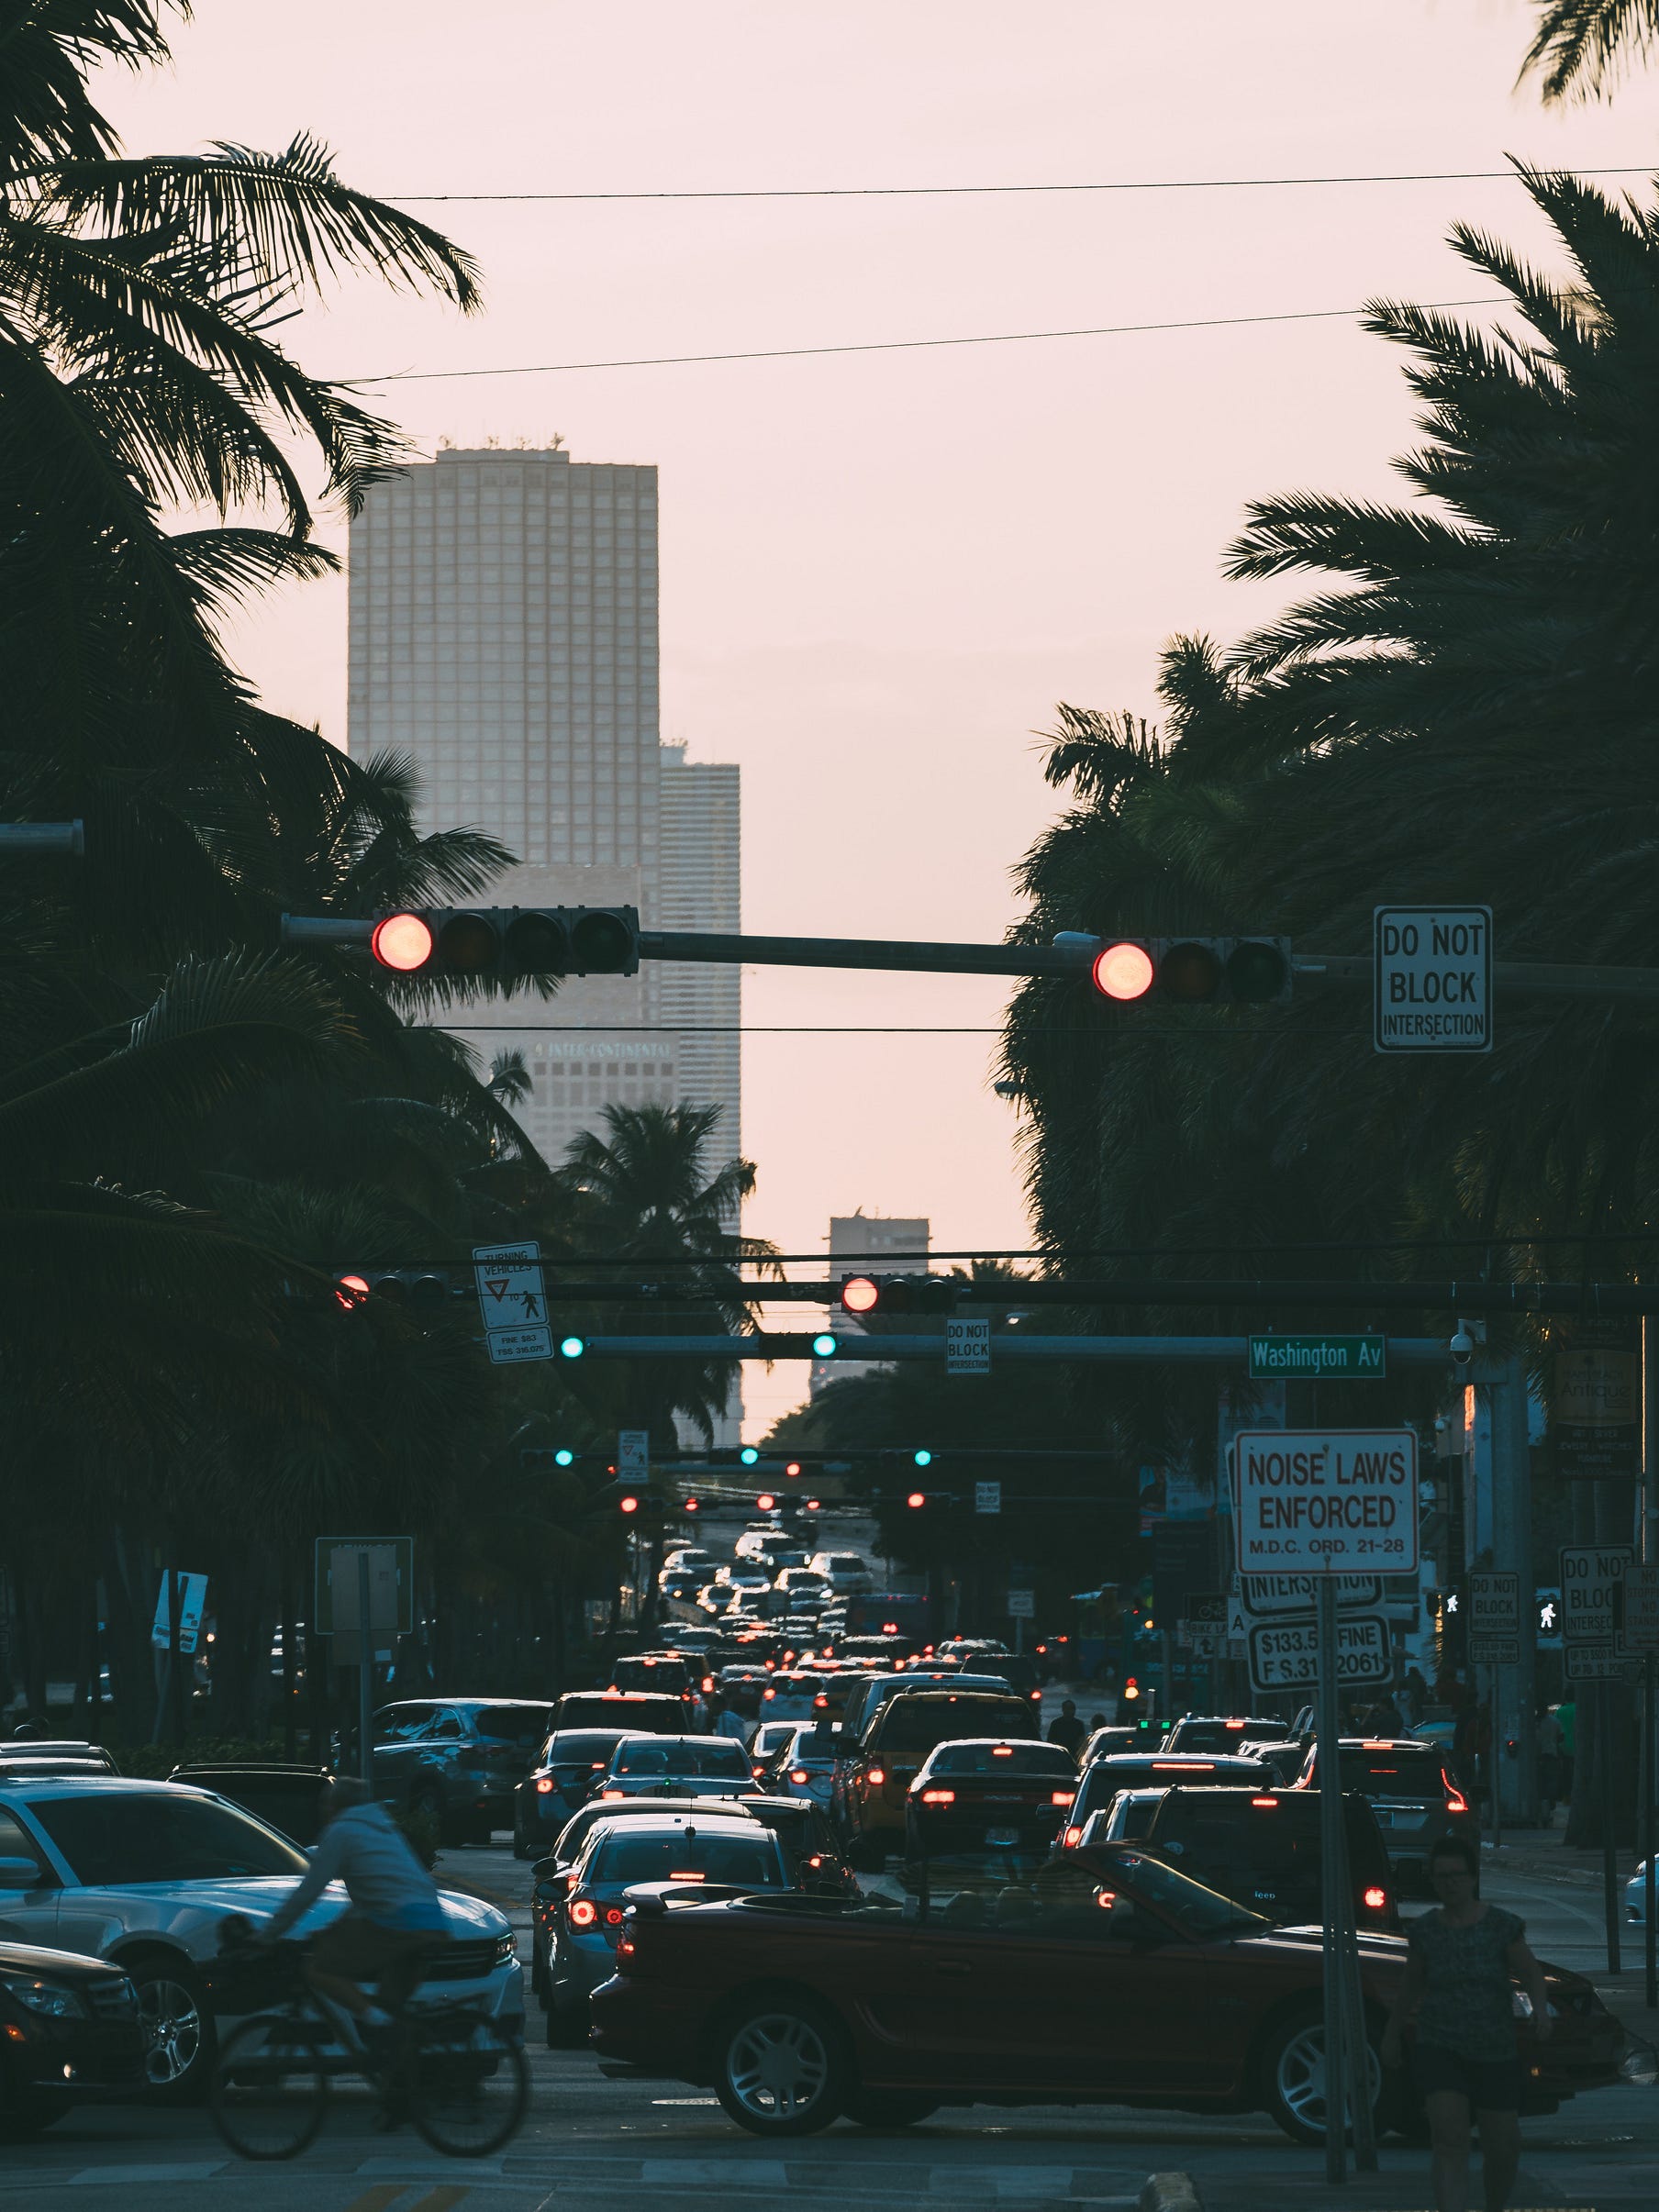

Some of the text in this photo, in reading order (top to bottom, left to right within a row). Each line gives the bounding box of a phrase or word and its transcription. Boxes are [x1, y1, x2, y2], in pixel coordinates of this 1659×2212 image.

[1384, 925, 1483, 956] DO NOT
[1390, 972, 1475, 1003] BLOCK
[1384, 1014, 1484, 1035] INTERSECTION
[502, 1334, 536, 1345] FINE $83
[948, 1325, 988, 1338] DO NOT
[948, 1343, 988, 1356] BLOCK
[1253, 1342, 1381, 1374] Washington Av
[1562, 1382, 1631, 1404] Antique
[1248, 1451, 1405, 1485] NOISE LAWS
[1259, 1495, 1396, 1529] ENFORCED
[1249, 1539, 1404, 1553] M.D.C. ORD. 21-28
[1564, 1558, 1588, 1578] DO
[1642, 1570, 1656, 1584] NO
[1248, 1575, 1373, 1598] INTERSION
[1473, 1579, 1515, 1594] DO NOT
[1627, 1587, 1659, 1598] STOPP
[1570, 1588, 1612, 1609] BLOC
[1475, 1599, 1514, 1615] BLOCK
[1642, 1601, 1656, 1613] NO
[1567, 1615, 1612, 1630] INTERSEC
[1627, 1616, 1659, 1627] STAND
[1262, 1626, 1376, 1655] $133.5 FINE
[1254, 1889, 1276, 1900] Jeep
